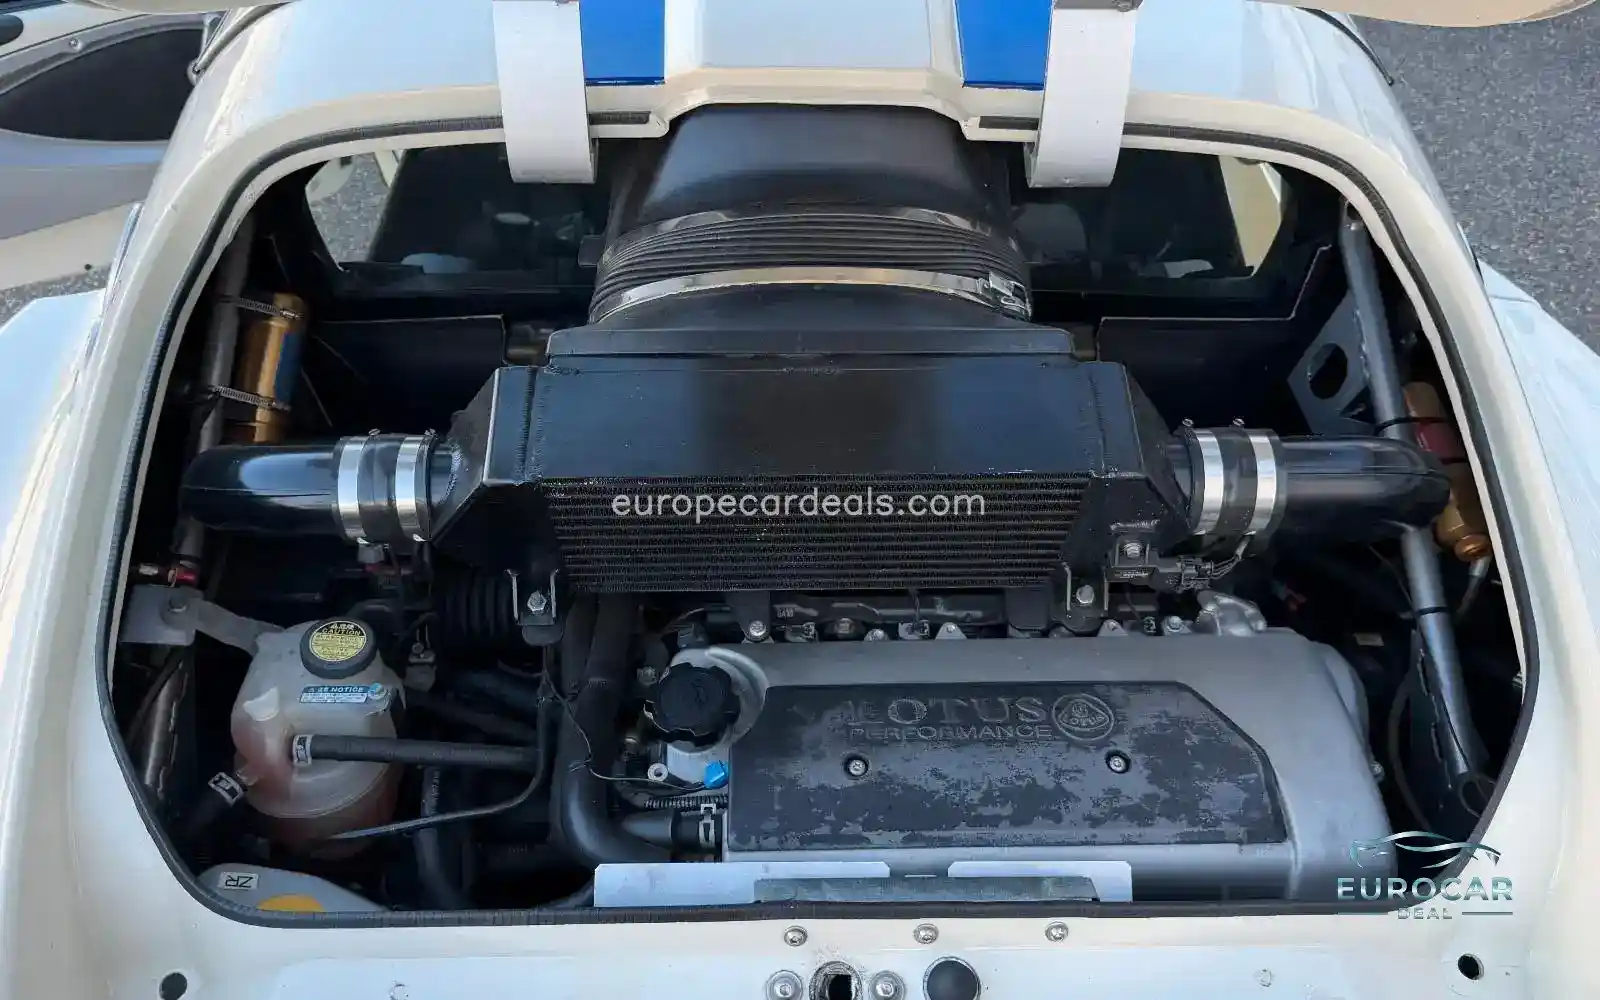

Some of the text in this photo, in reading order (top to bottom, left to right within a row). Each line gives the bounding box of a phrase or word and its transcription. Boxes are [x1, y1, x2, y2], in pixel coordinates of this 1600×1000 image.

[322, 627, 361, 636] CAUTION
[849, 697, 1047, 725] LOTUS
[850, 725, 1052, 740] PERFORMANCE
